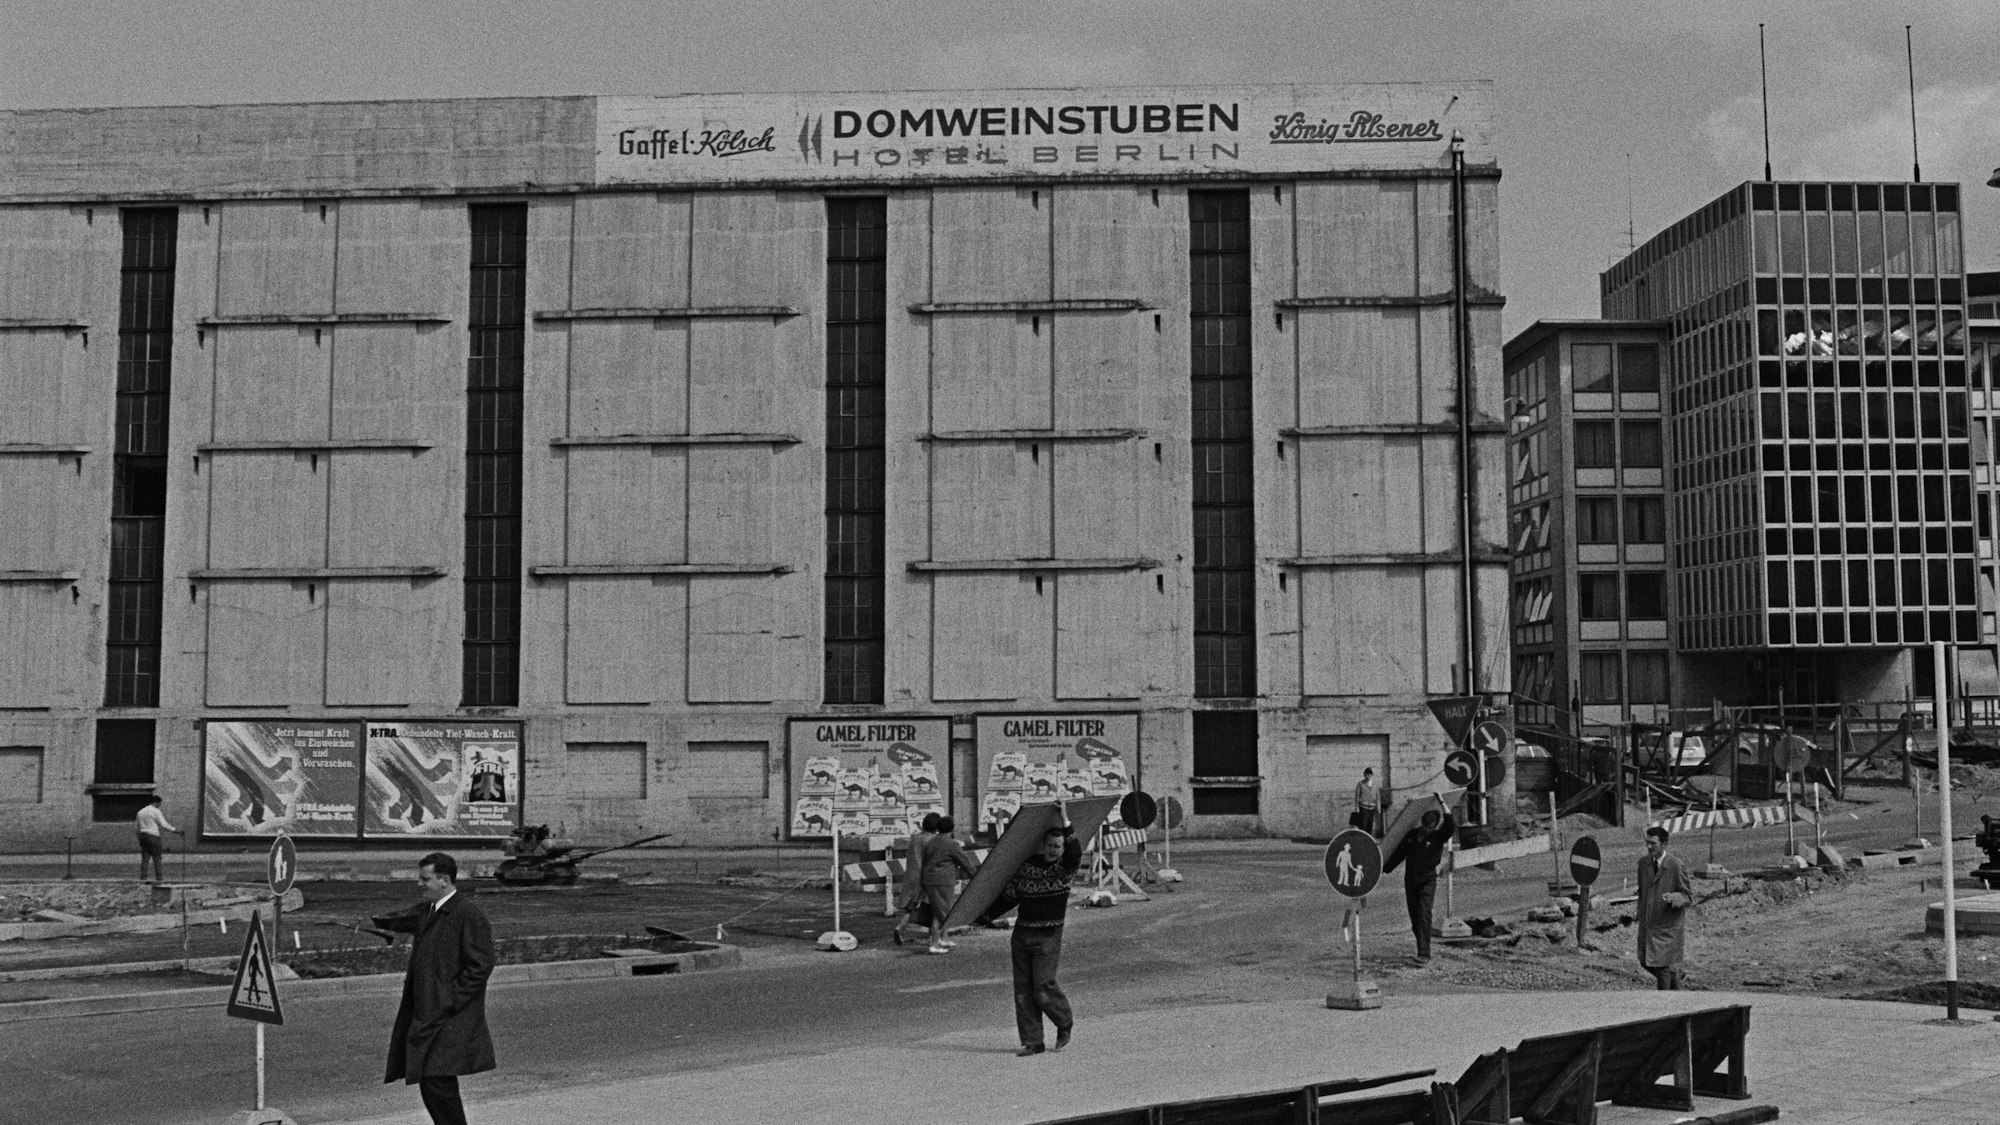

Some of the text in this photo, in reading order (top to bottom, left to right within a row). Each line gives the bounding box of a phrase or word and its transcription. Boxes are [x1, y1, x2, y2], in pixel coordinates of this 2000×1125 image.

[833, 102, 1239, 138] DOMWEINSTUBEN
[833, 143, 1239, 167] HOTEL BERLIN
[1444, 705, 1467, 718] HALT
[274, 728, 350, 737] Jetzt kommt Kraft
[816, 724, 916, 742] CAMEL FILTER
[1003, 719, 1105, 737] CAMEL FILTER
[308, 738, 355, 748] Einweichen
[312, 748, 328, 757] und
